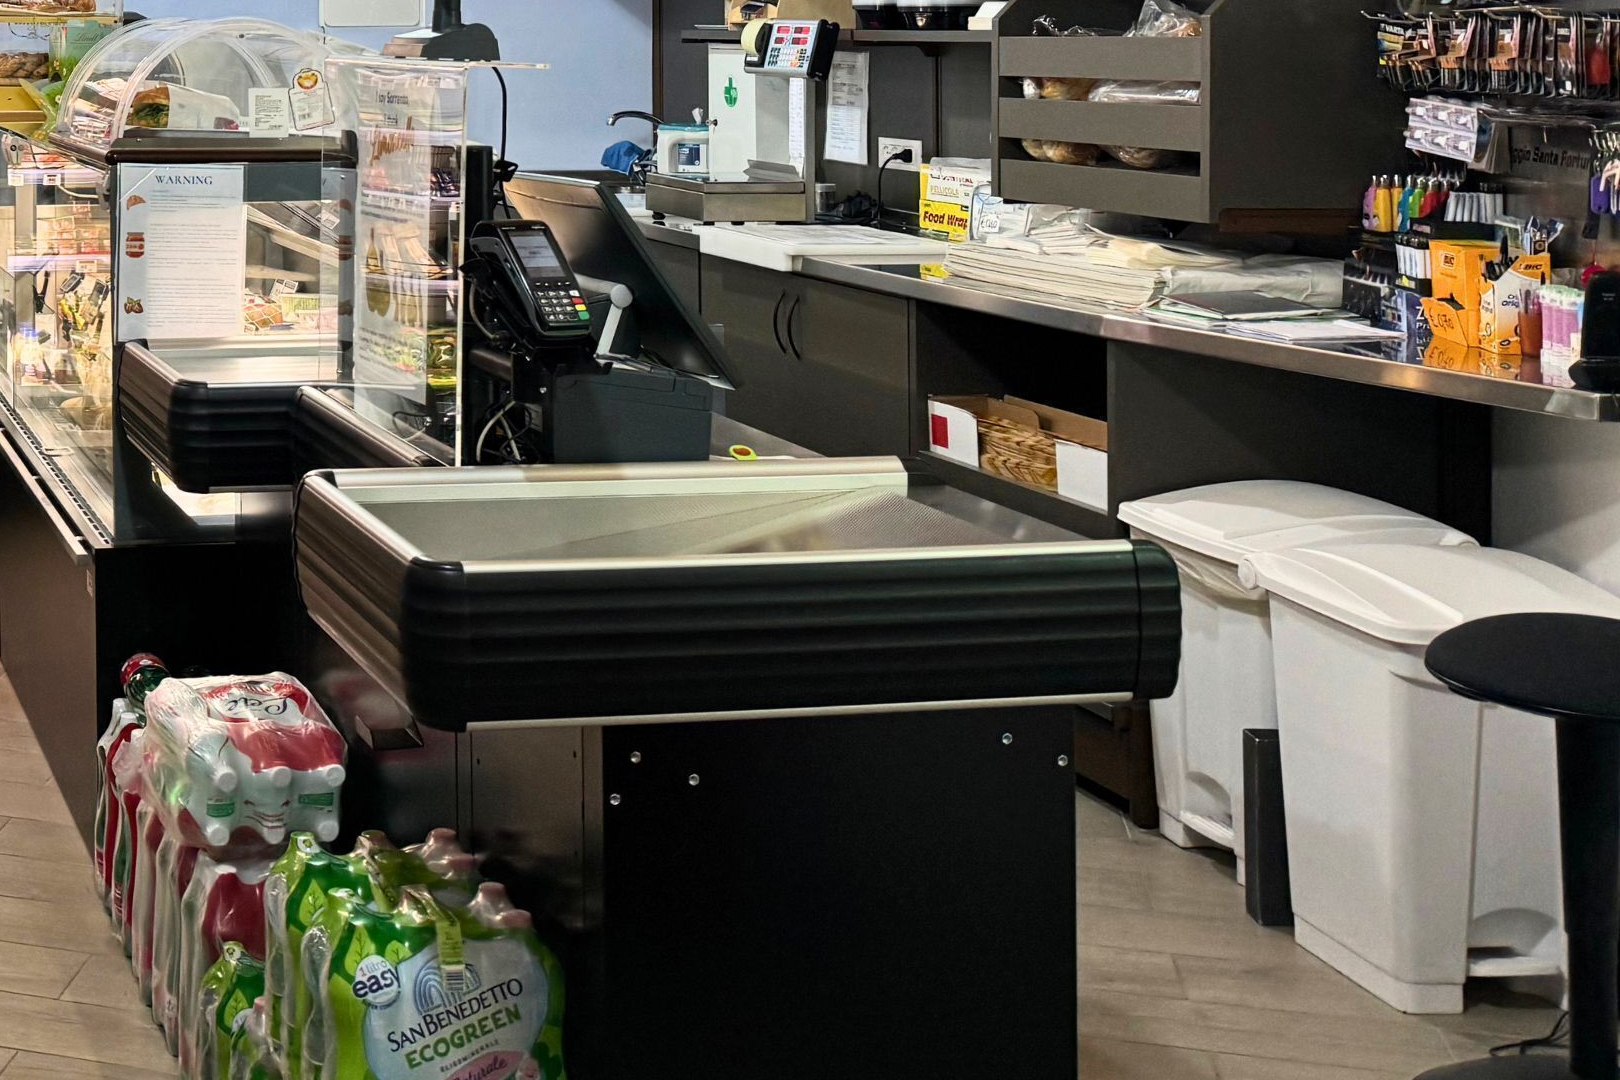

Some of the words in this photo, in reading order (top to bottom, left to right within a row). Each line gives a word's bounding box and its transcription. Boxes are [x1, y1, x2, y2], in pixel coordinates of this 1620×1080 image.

[1533, 146, 1559, 167] Santa
[155, 175, 213, 185] WARNING
[923, 210, 946, 225] Food
[1442, 252, 1455, 267] BIC
[1522, 263, 1543, 271] BIC
[360, 966, 367, 978] 1
[367, 960, 388, 974] litro
[352, 967, 401, 999] easy
[403, 1002, 523, 1070] ECOGREEN
